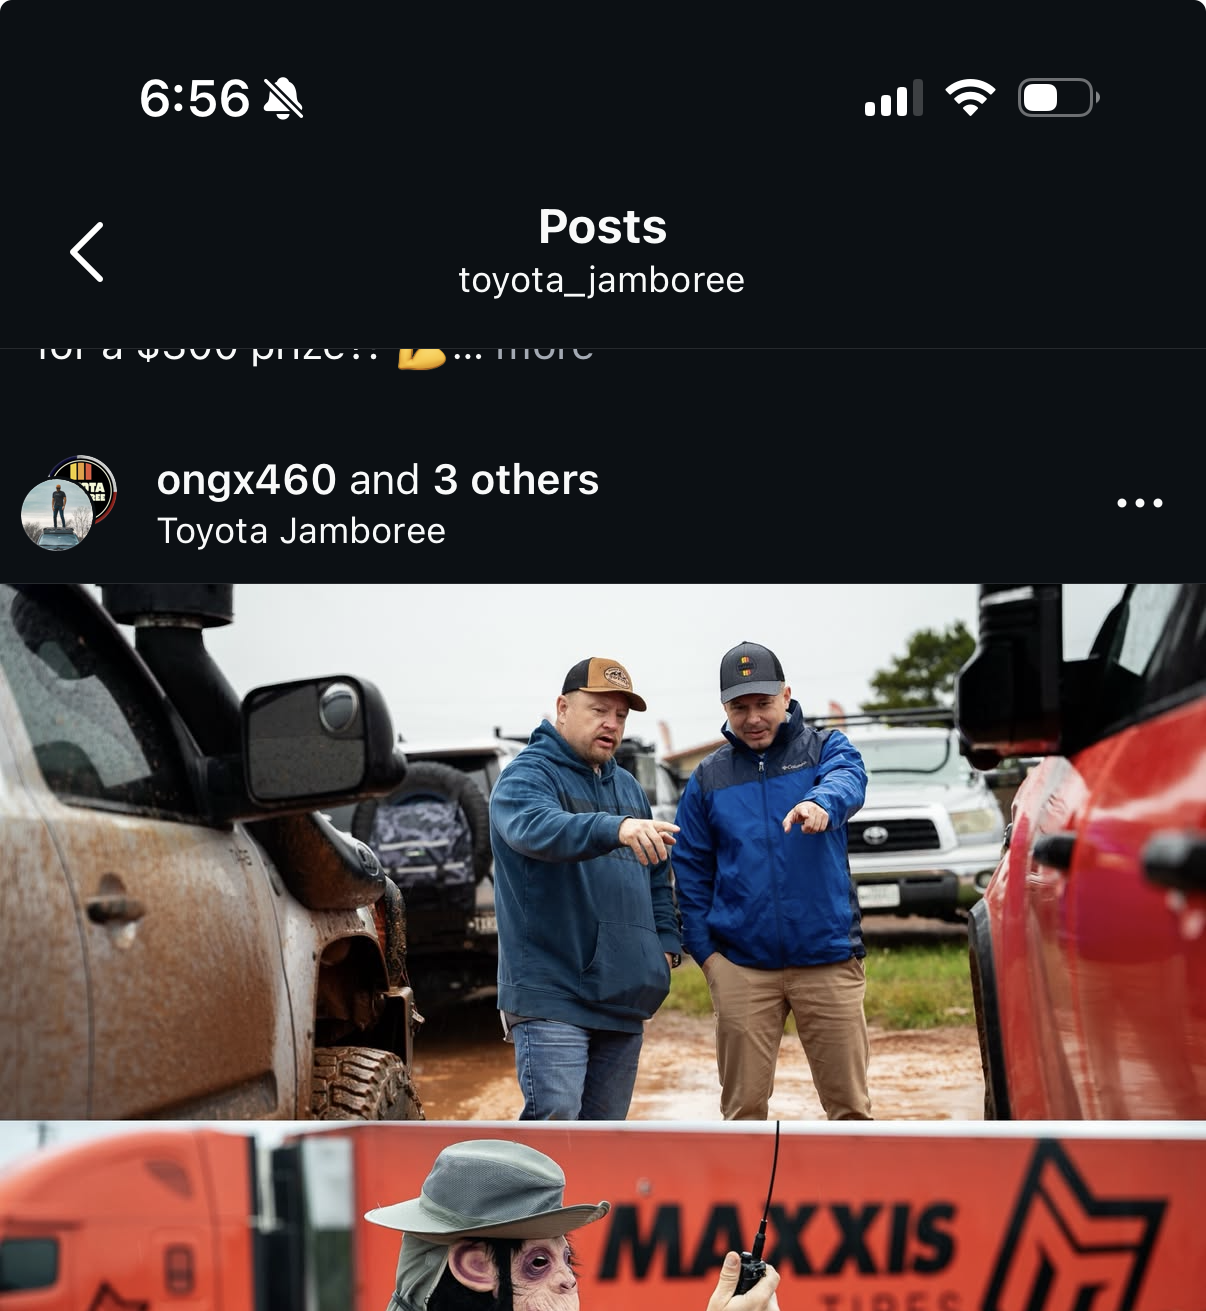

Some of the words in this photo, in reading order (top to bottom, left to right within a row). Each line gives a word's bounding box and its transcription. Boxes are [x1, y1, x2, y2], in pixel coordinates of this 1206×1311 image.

[141, 79, 249, 118] 6:56
[541, 208, 666, 245] Posts
[459, 264, 744, 299] toyota_jamboree
[158, 463, 335, 503] ongx460
[351, 463, 418, 495] and
[435, 463, 457, 495] 3
[472, 463, 598, 495] others
[157, 516, 266, 551] Toyota
[280, 516, 445, 545] Jamboree
[597, 1202, 957, 1282] MAXXIS
